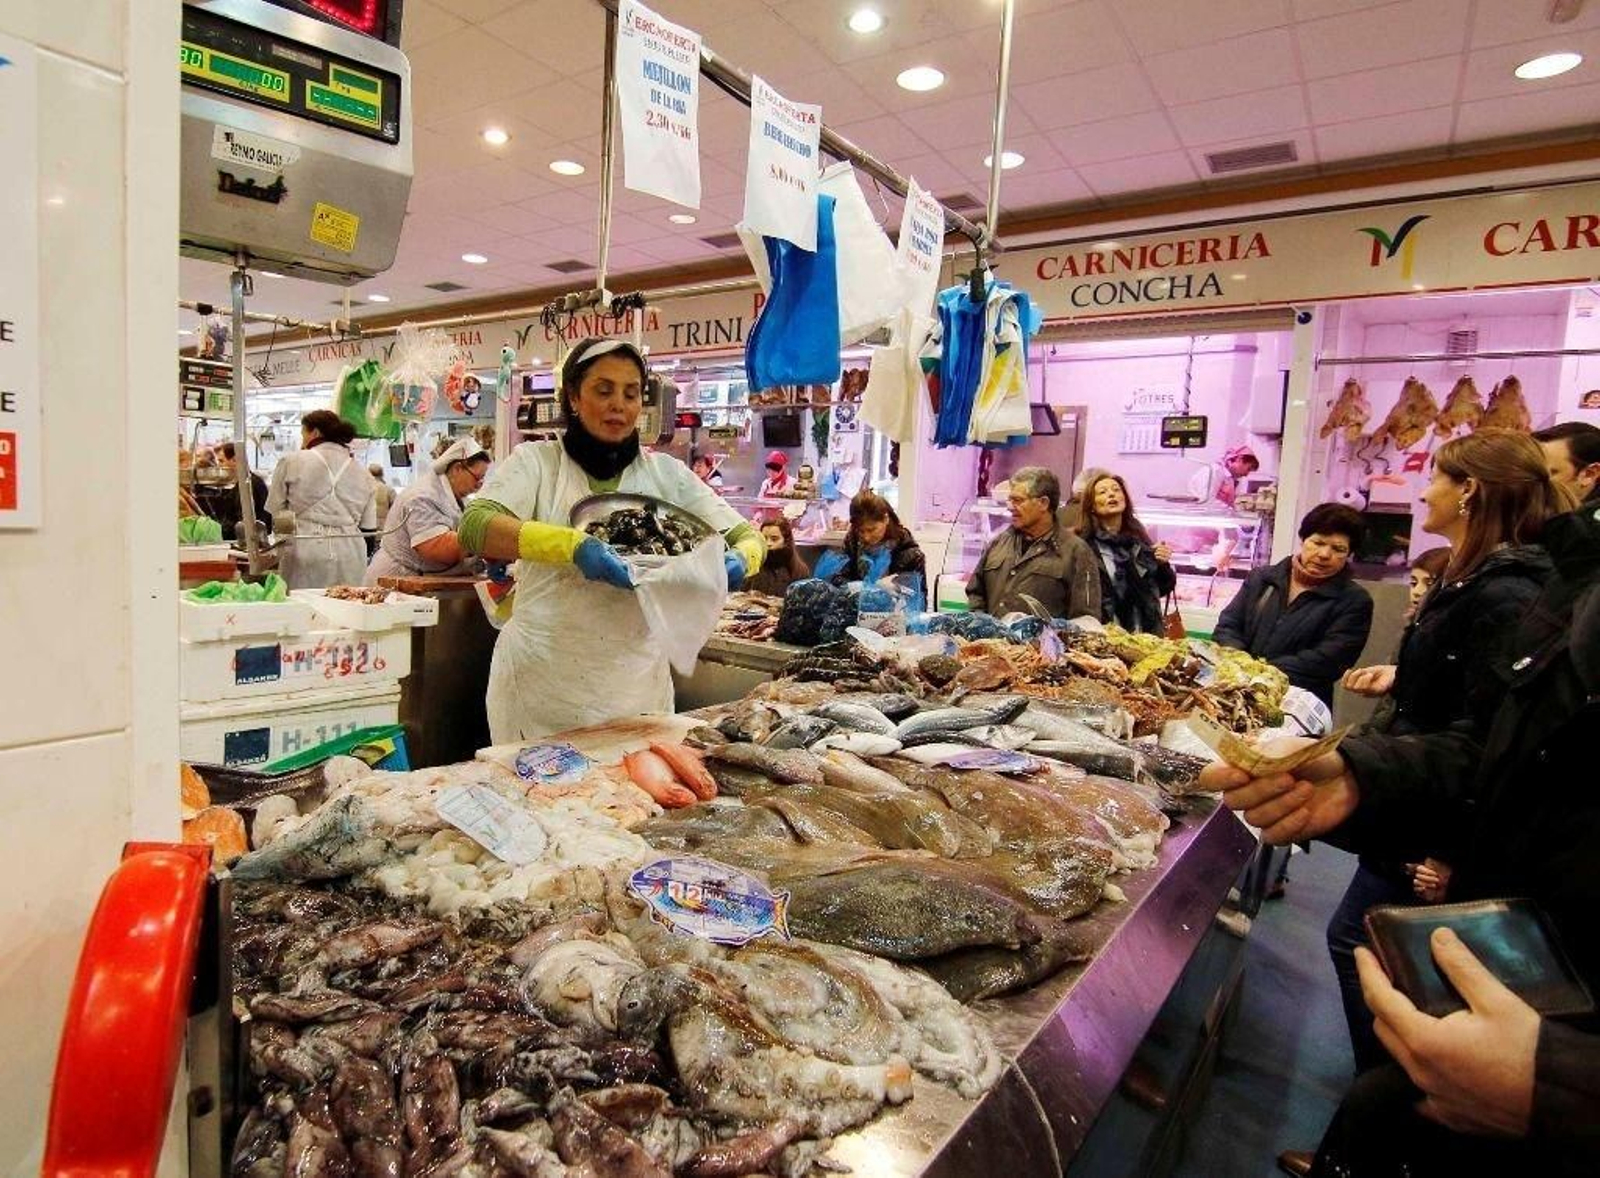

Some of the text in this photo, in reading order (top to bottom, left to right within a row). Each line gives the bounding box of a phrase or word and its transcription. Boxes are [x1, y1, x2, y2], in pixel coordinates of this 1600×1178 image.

[1036, 232, 1272, 280] CARNICERIA
[1071, 272, 1225, 307] CONCHA
[667, 316, 743, 348] TRINI
